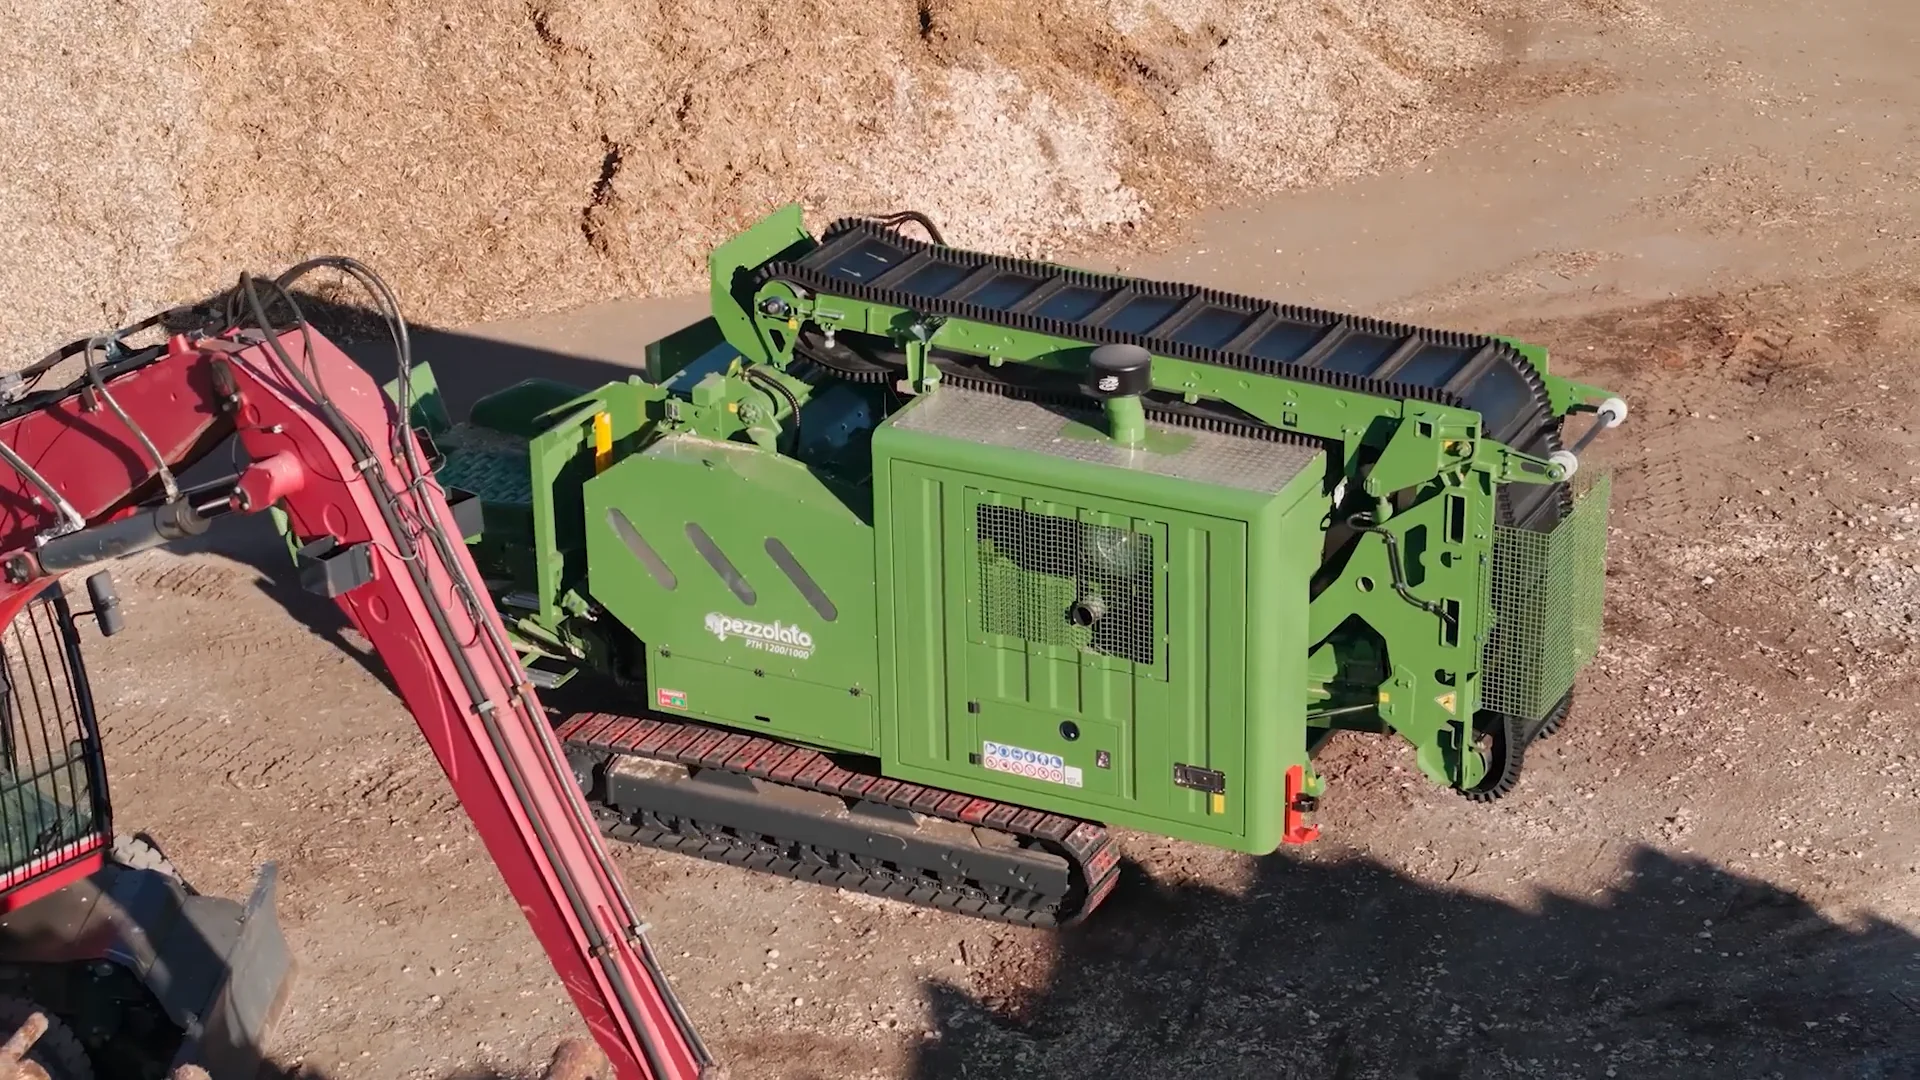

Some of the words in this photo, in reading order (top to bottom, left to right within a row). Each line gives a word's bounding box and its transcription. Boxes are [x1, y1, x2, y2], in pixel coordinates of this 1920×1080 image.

[719, 616, 812, 647] pezzolato
[745, 639, 763, 650] PTH
[765, 642, 810, 660] 1200/1000
